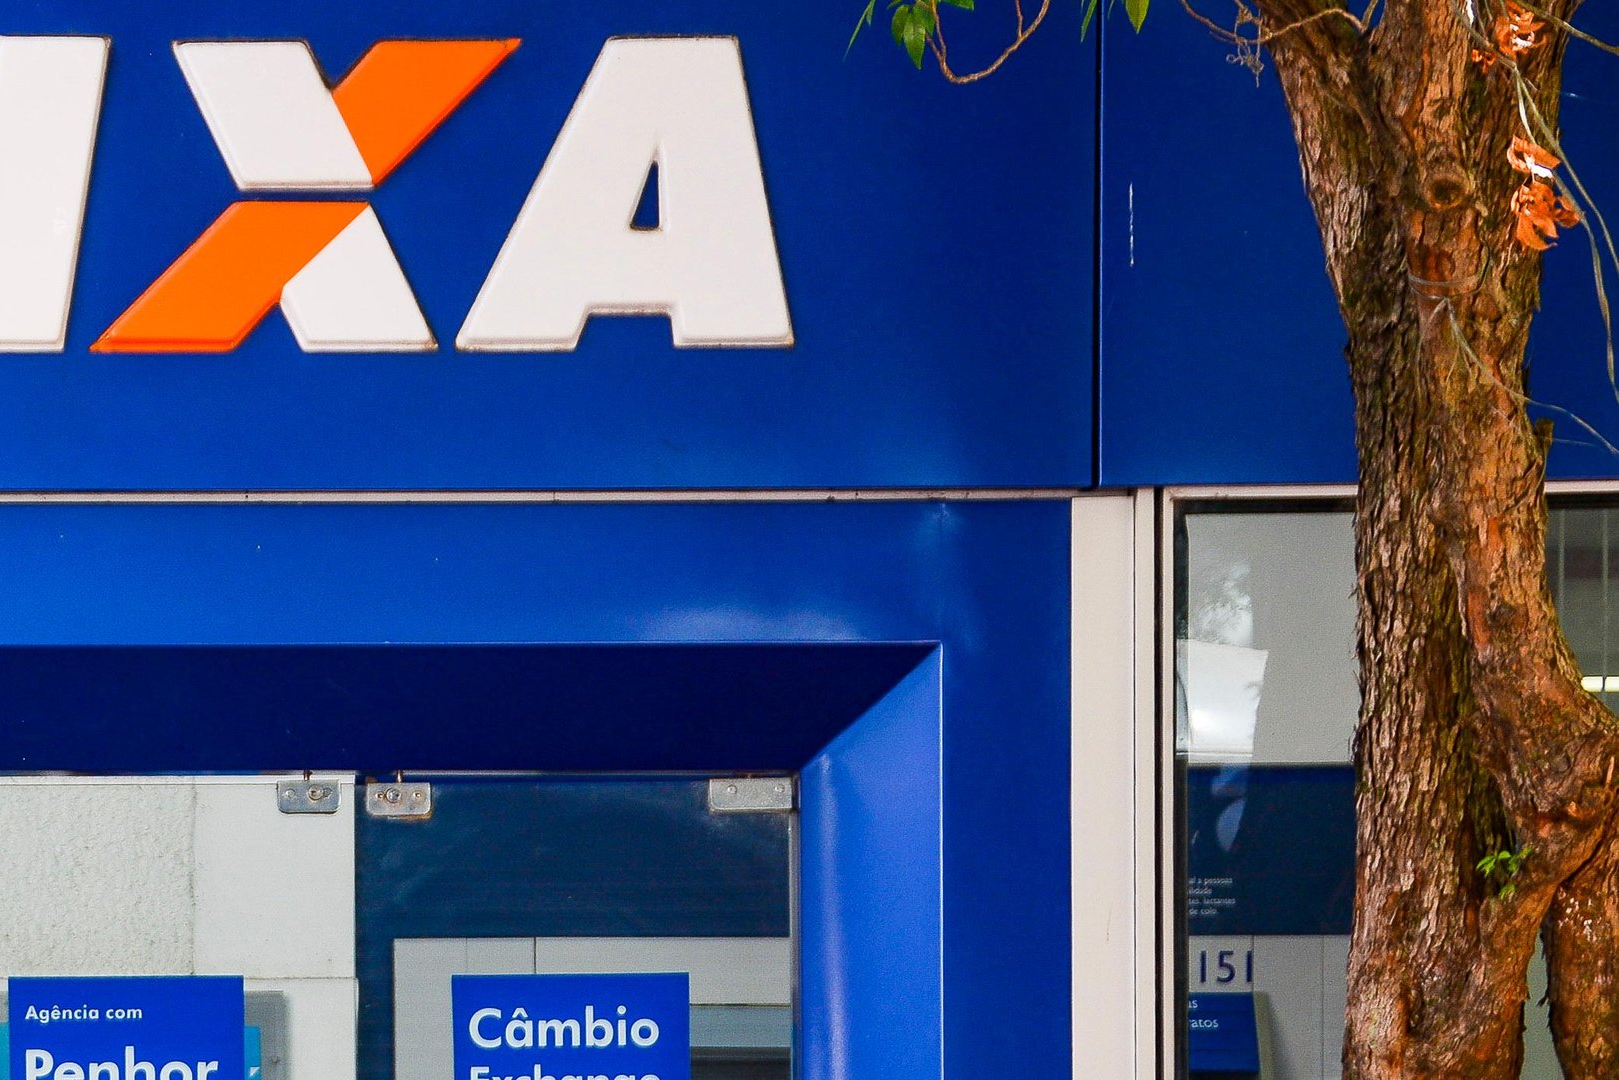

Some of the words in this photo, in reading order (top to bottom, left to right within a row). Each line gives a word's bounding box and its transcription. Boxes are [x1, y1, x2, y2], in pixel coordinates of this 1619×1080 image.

[1200, 950, 1253, 982] 151
[26, 1005, 98, 1023] Agência
[106, 1009, 142, 1019] com
[469, 1006, 659, 1048] Câmbio
